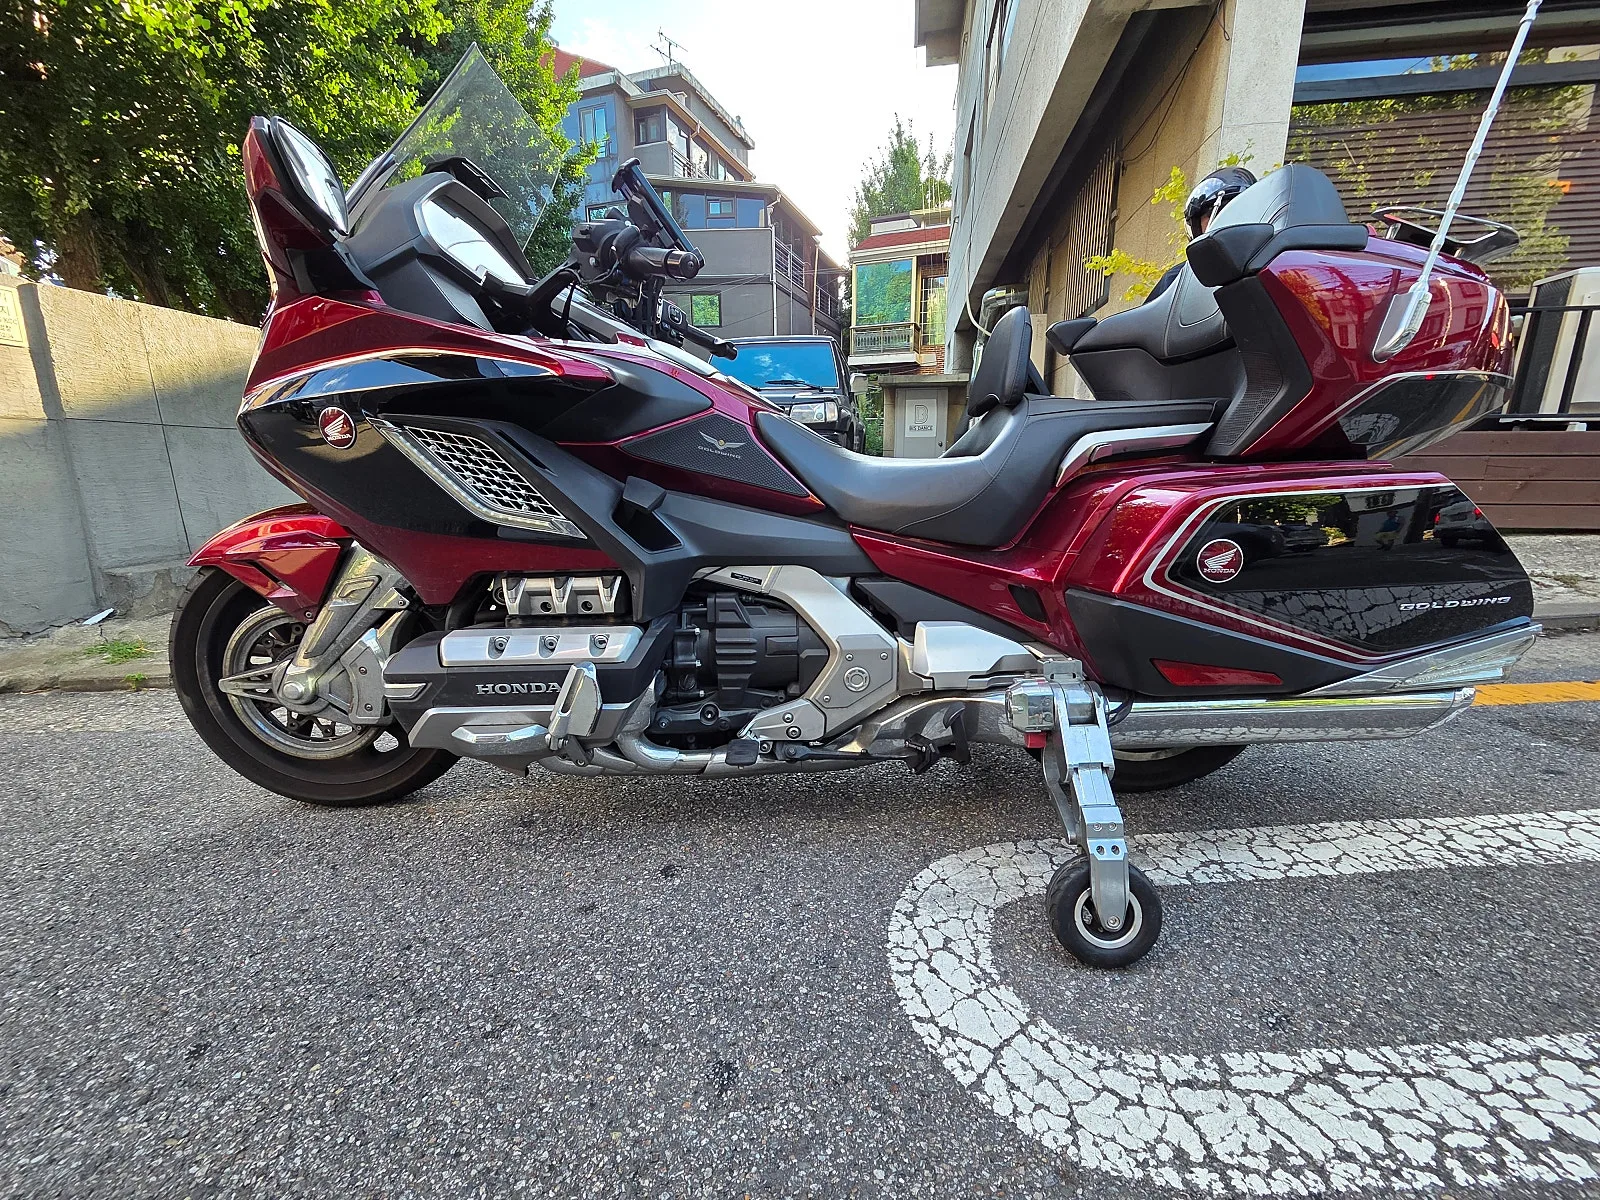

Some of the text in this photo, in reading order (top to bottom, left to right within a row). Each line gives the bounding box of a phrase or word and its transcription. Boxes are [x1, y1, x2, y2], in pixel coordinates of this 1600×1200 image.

[326, 433, 353, 441] HONDA
[697, 445, 741, 459] GOLDWING
[1400, 596, 1512, 611] GOLDWING
[475, 682, 562, 695] HONDA
